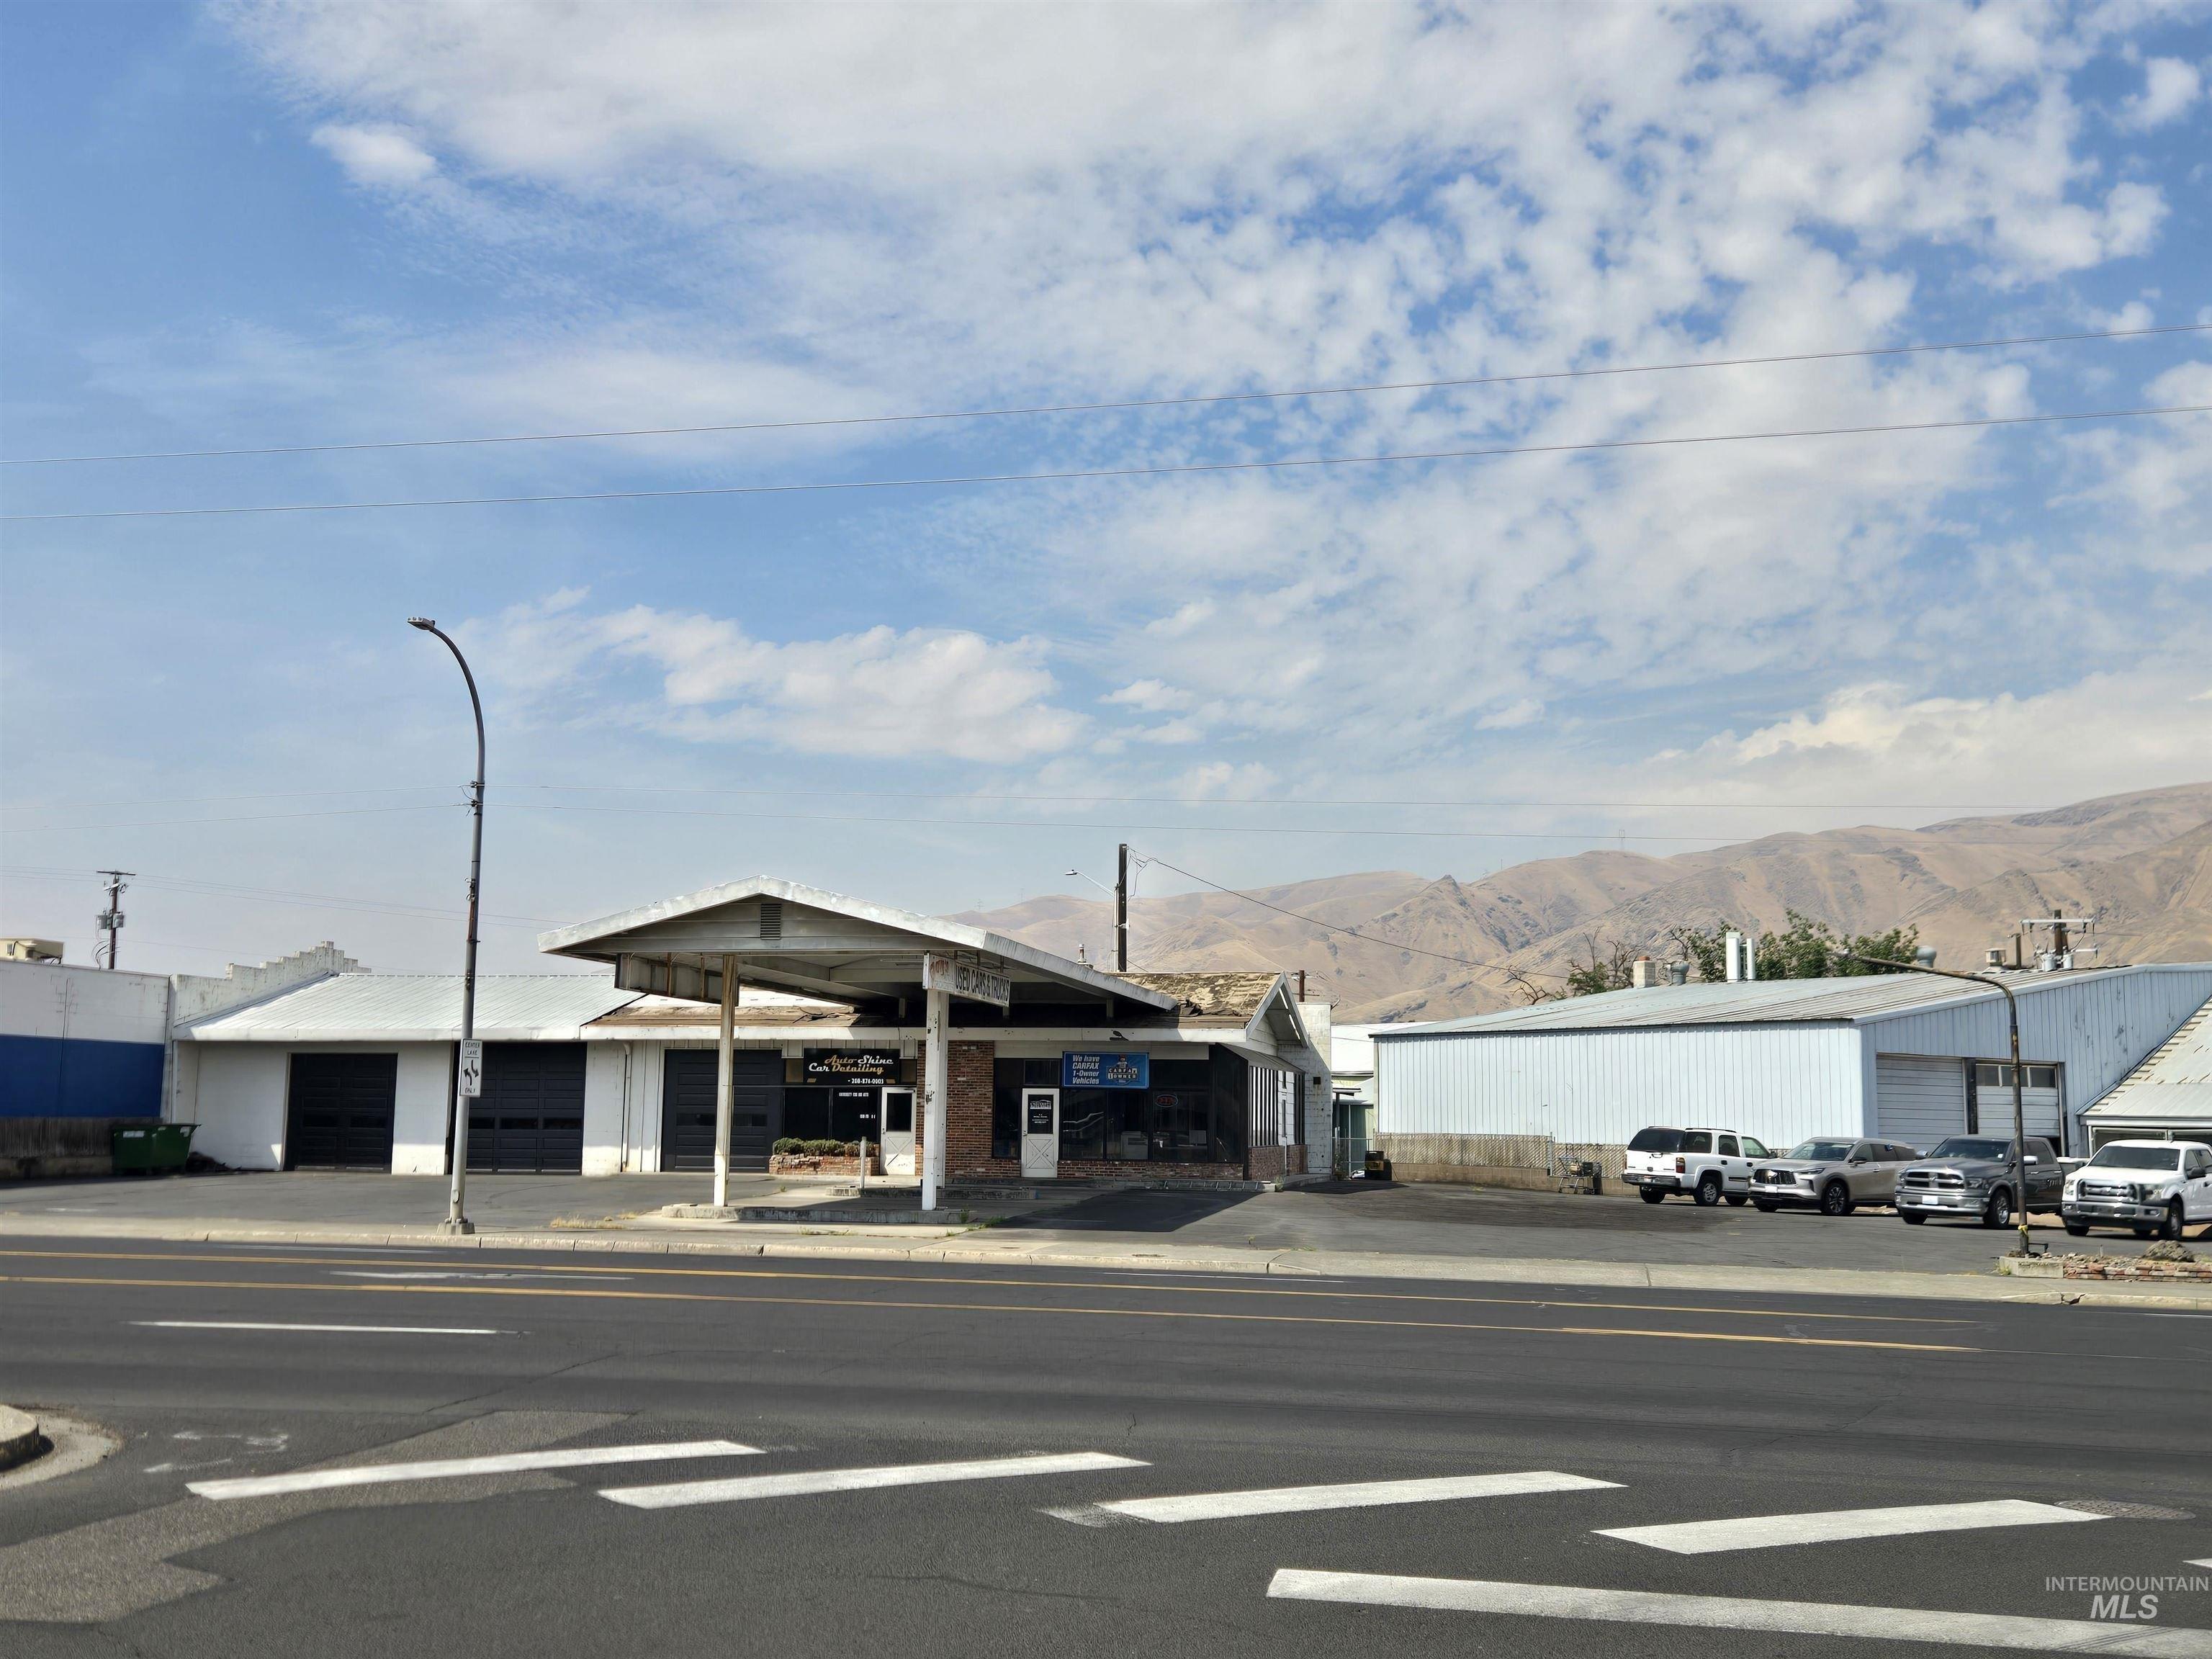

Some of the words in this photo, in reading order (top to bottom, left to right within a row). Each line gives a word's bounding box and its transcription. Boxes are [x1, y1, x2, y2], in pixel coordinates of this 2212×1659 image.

[956, 964, 970, 992] USED
[971, 969, 986, 996] CARS
[824, 1054, 857, 1065] Auto
[858, 1055, 894, 1064] Shine
[809, 1063, 830, 1072] Car
[832, 1063, 884, 1075] Detailing
